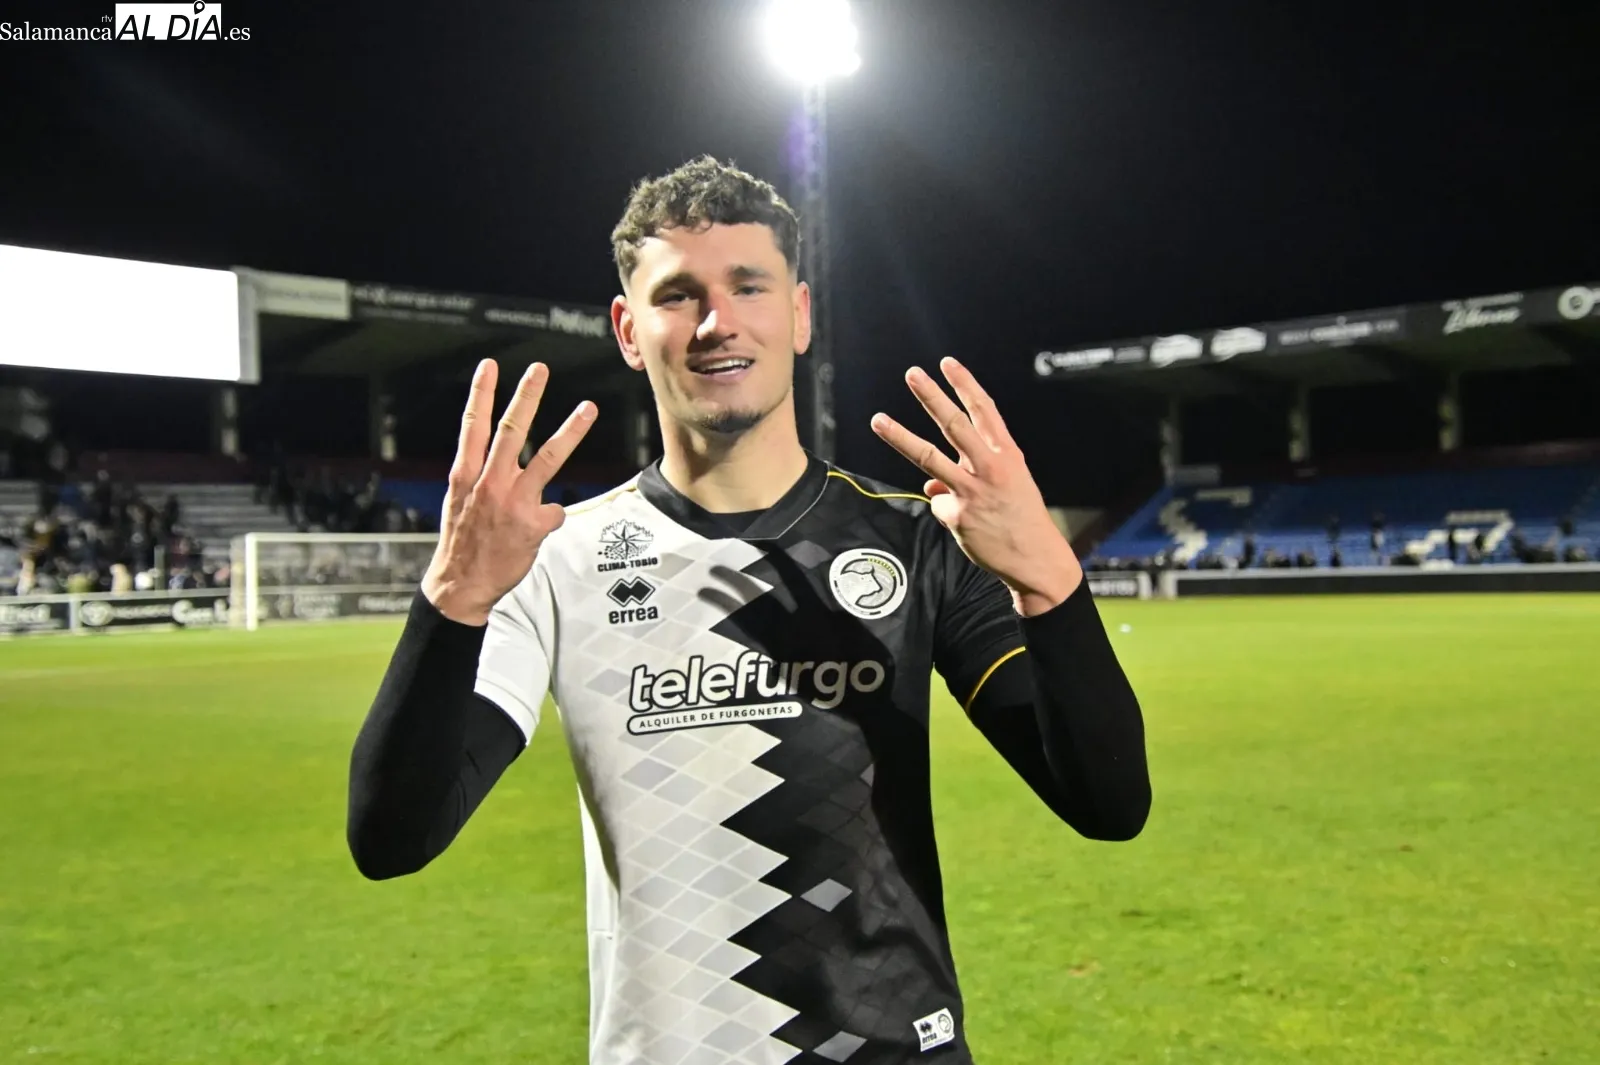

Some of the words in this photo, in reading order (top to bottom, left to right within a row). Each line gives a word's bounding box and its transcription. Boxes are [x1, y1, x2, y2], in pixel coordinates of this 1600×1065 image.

[608, 606, 659, 625] errea
[628, 650, 885, 713] telefurgo
[639, 714, 696, 729] ALQUILER
[701, 711, 715, 721] DE
[719, 706, 793, 719] FURGONETAS
